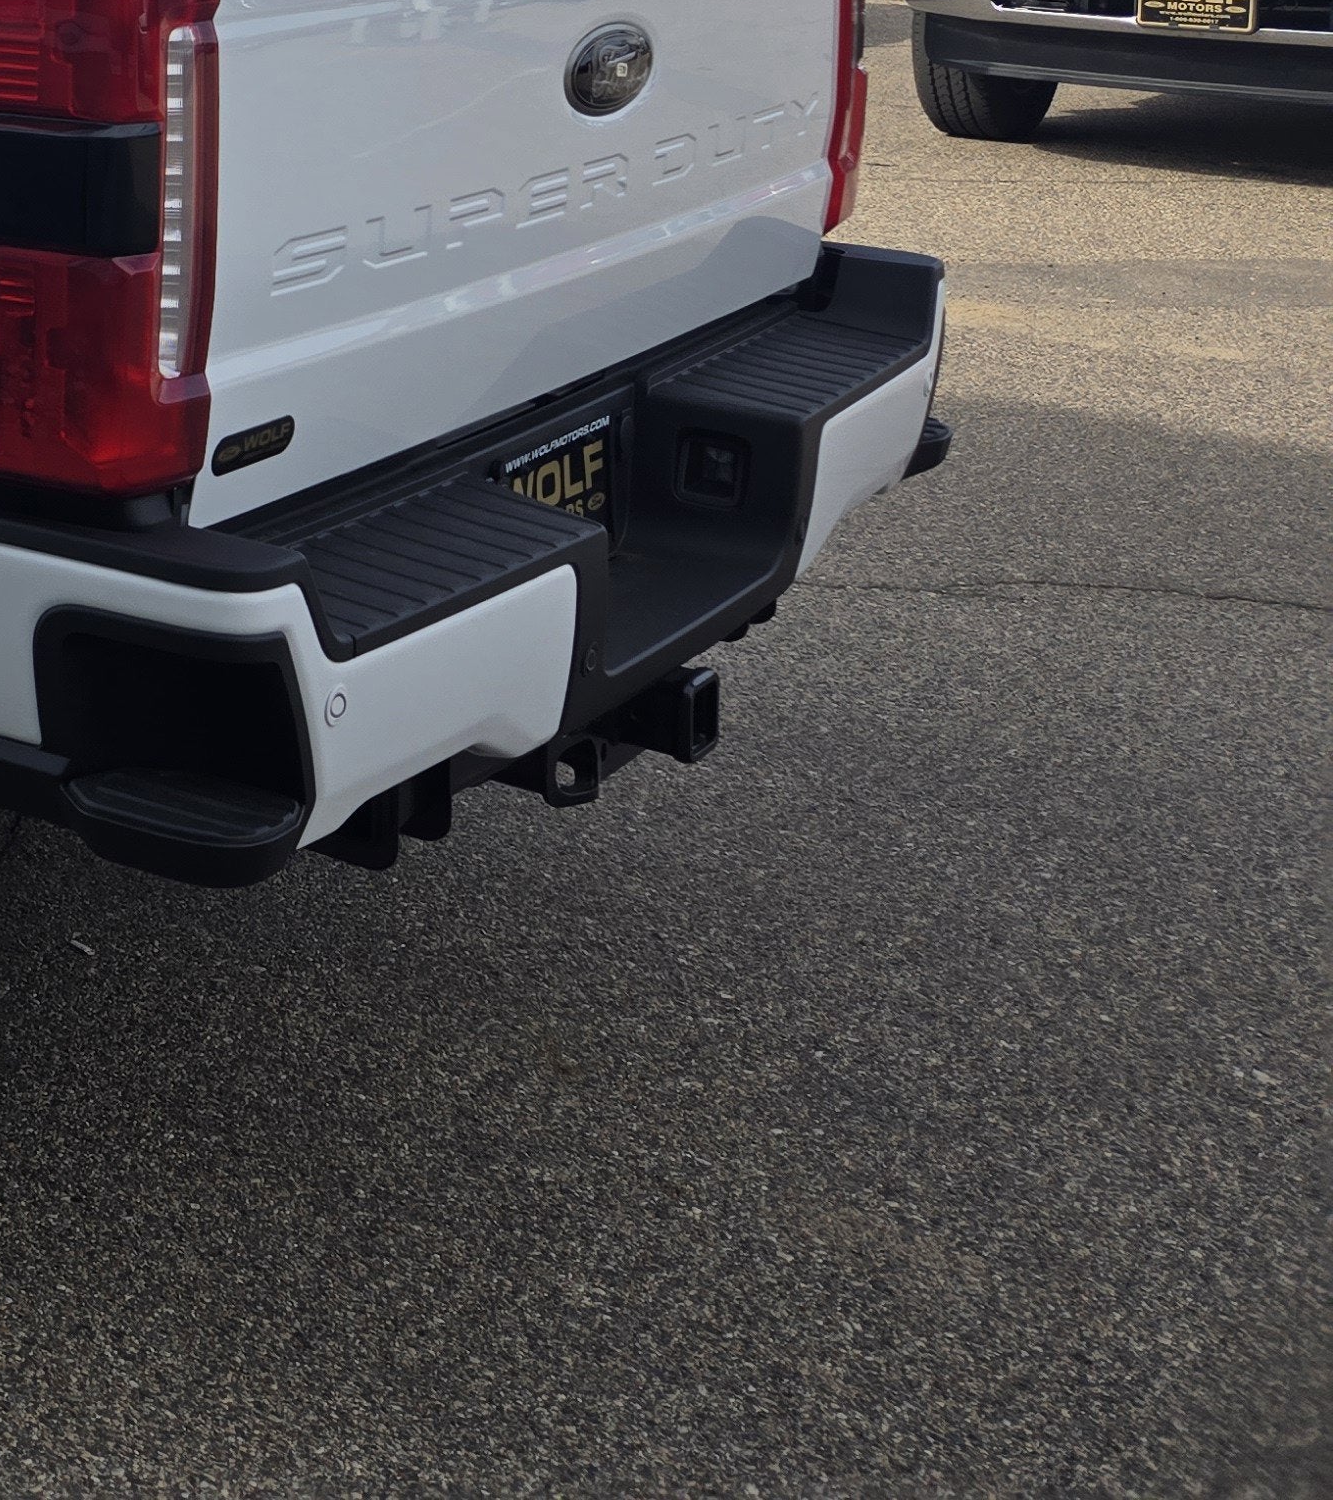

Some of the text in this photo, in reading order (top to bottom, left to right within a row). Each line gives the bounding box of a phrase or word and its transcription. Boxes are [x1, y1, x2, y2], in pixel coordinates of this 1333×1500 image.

[1166, 2, 1223, 13] MOTORS
[270, 91, 822, 297] SUPER DUTY
[244, 422, 291, 452] WOLF
[505, 415, 611, 474] WWW.WOLFMOTORS.COM
